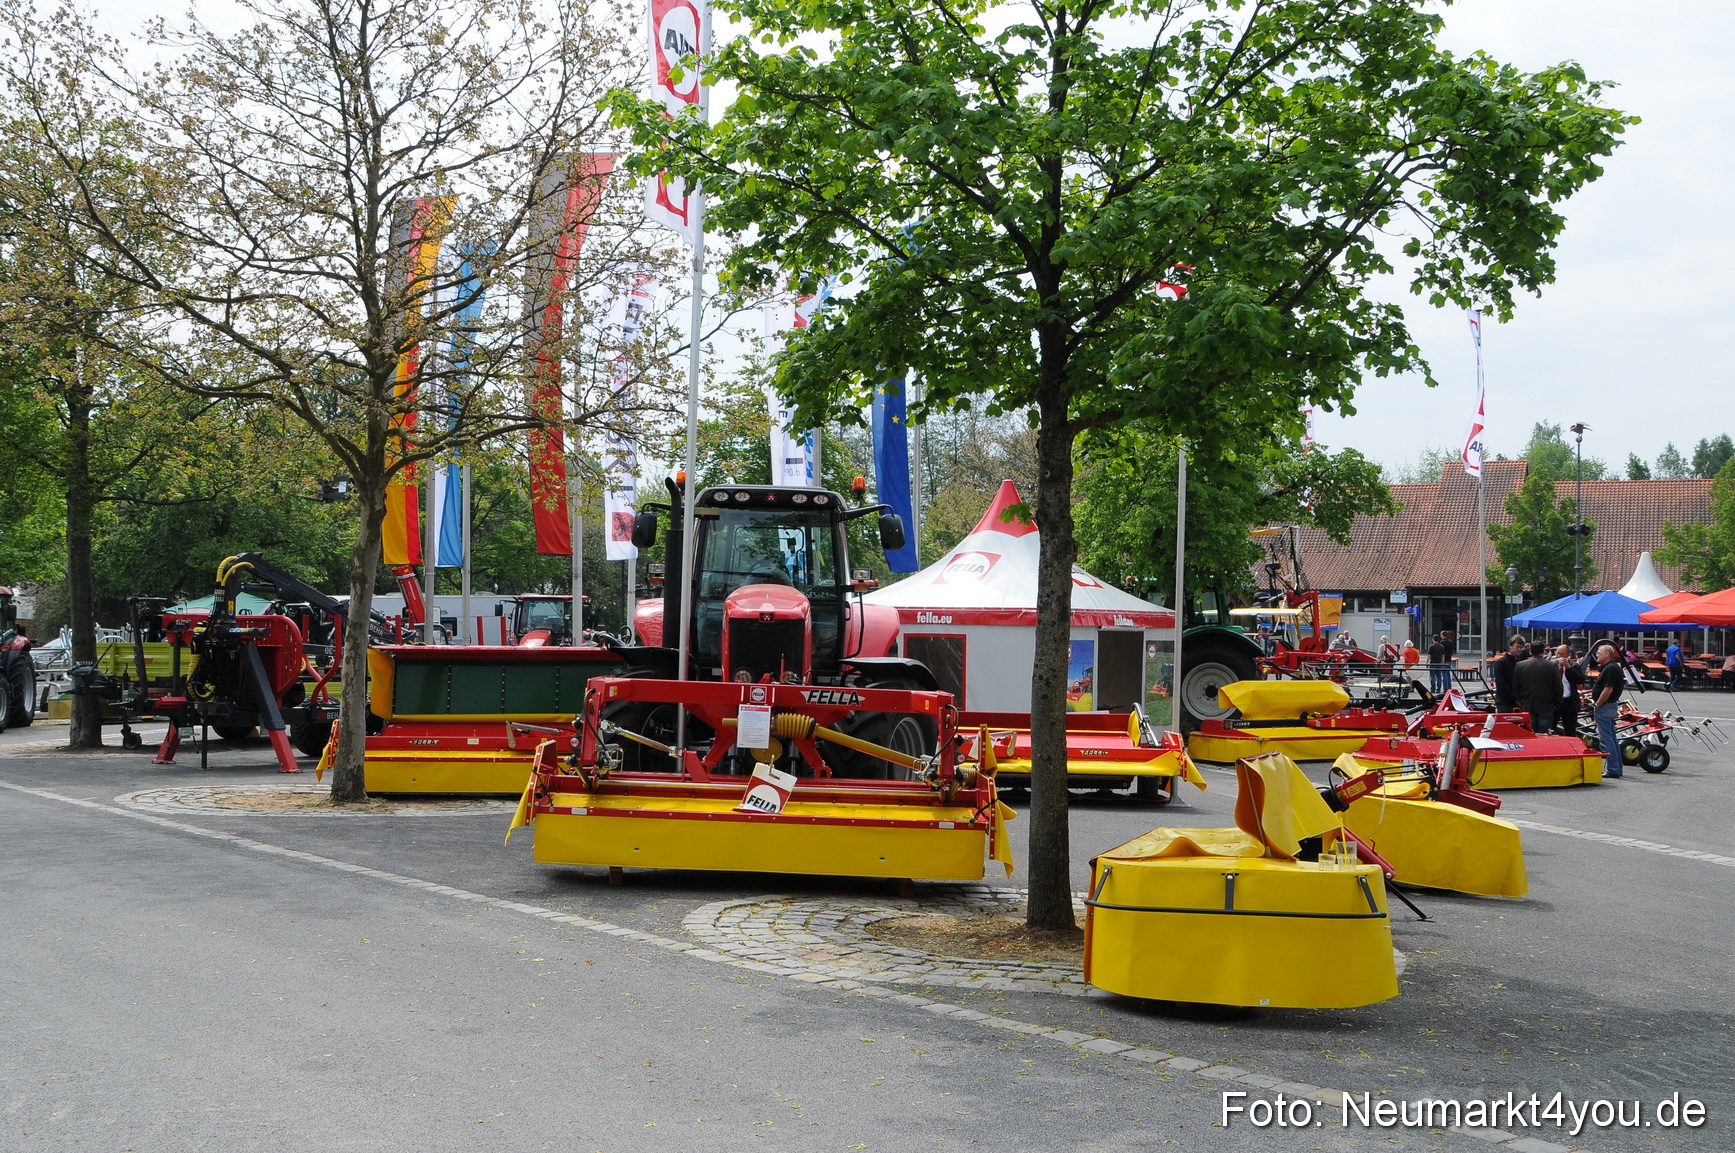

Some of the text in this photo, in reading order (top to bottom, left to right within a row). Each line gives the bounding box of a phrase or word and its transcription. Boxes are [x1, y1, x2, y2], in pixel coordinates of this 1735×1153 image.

[945, 563, 986, 574] FELLA
[917, 612, 953, 624] fella.eu
[806, 689, 861, 706] FELLA
[747, 794, 778, 814] FELLA
